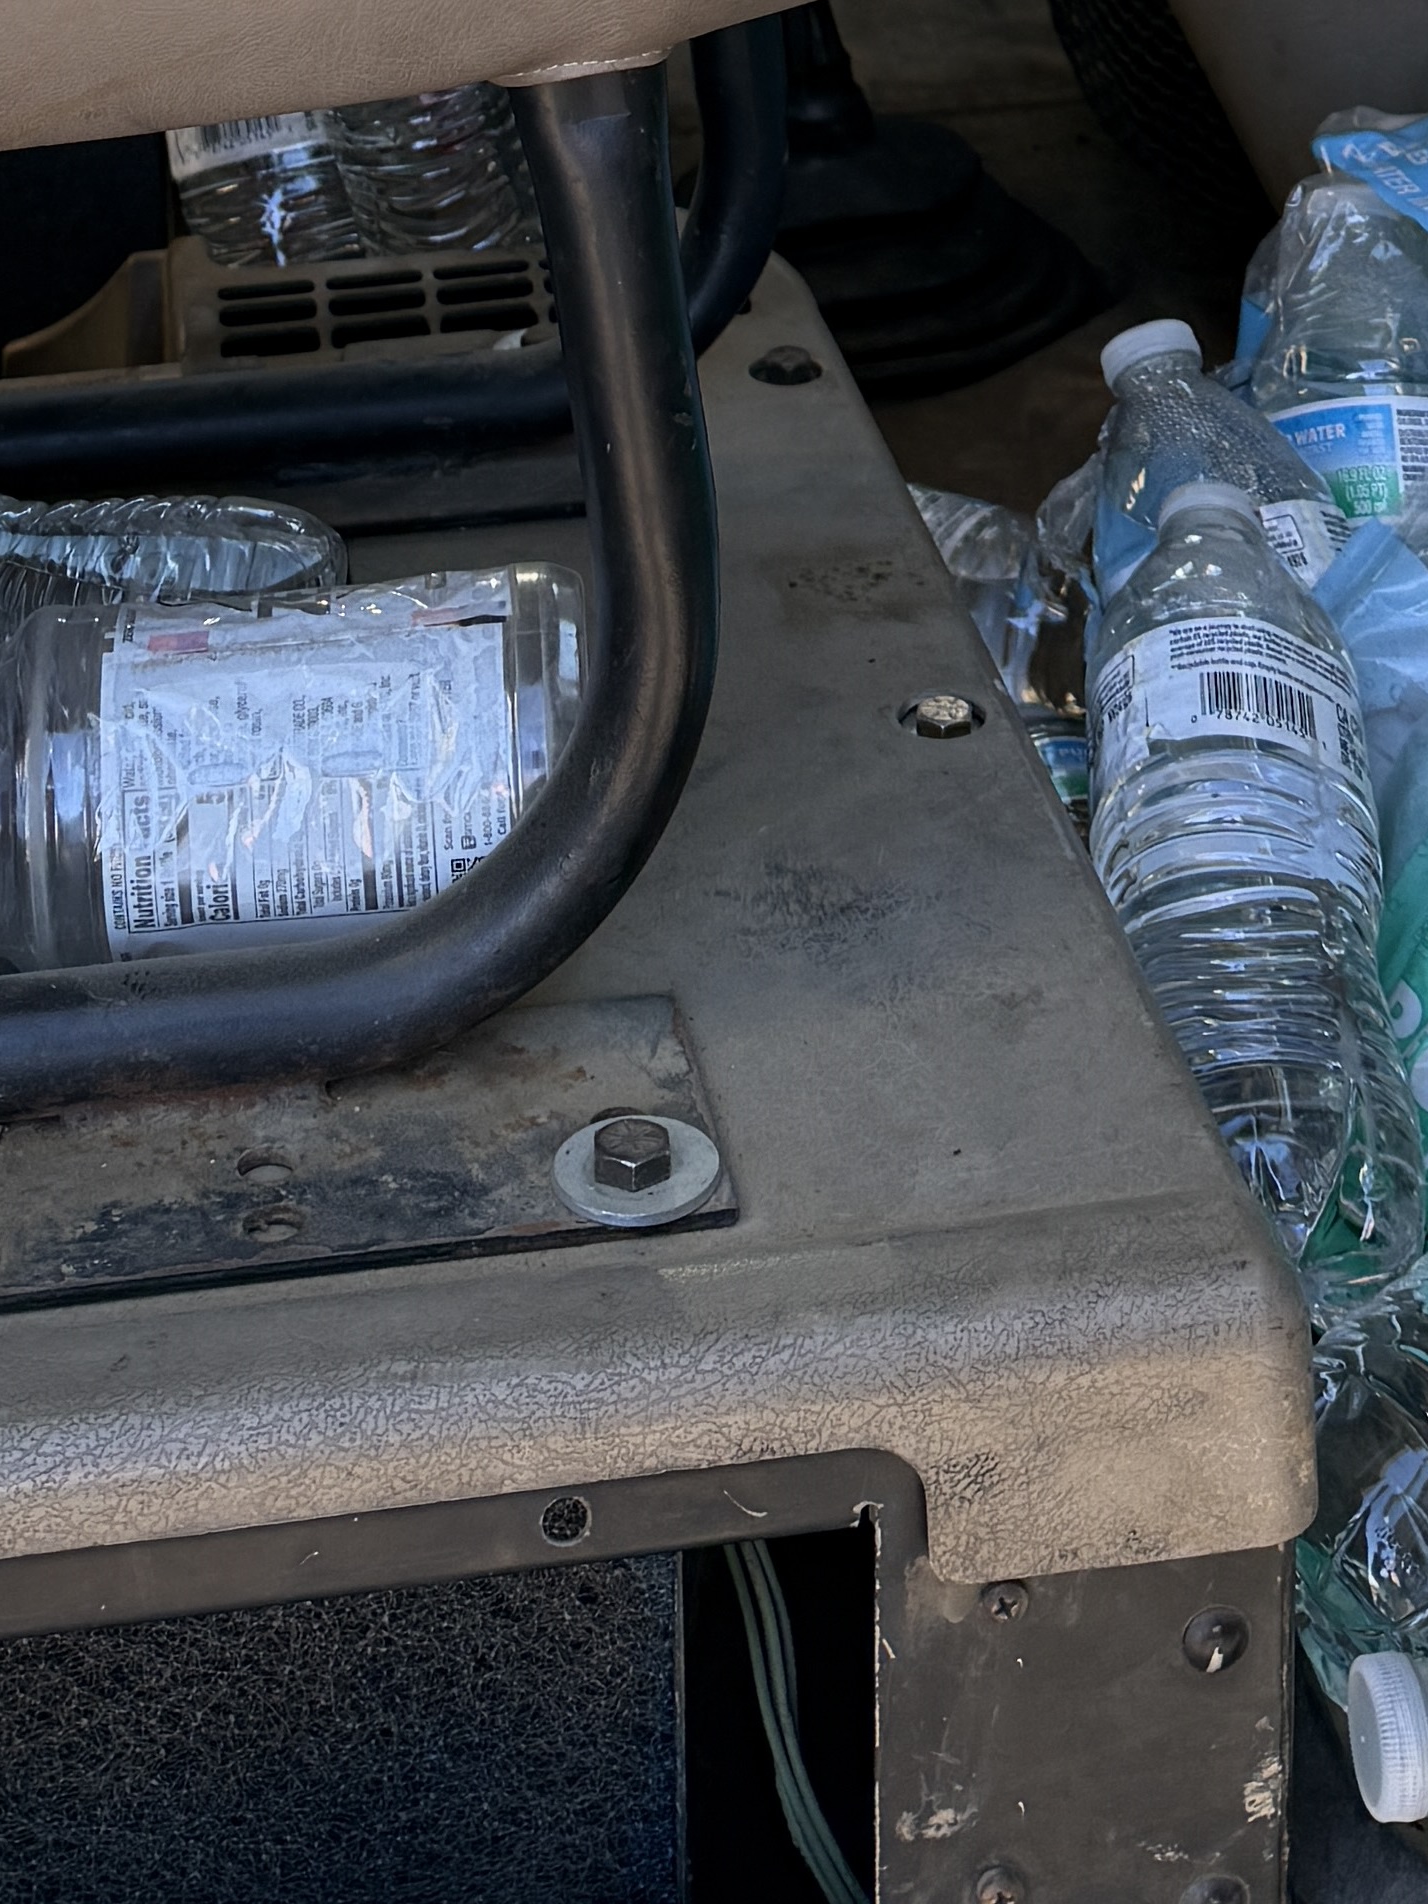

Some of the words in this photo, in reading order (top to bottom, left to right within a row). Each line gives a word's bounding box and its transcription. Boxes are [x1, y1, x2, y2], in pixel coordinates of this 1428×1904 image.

[1294, 422, 1346, 445] WATER
[1373, 466, 1385, 480] OZ
[1355, 500, 1371, 514] 500
[1217, 709, 1260, 724] 78742
[497, 816, 506, 834] Call
[443, 822, 453, 850] Scan
[130, 854, 156, 929] Nutrition
[206, 883, 231, 921] Calori
